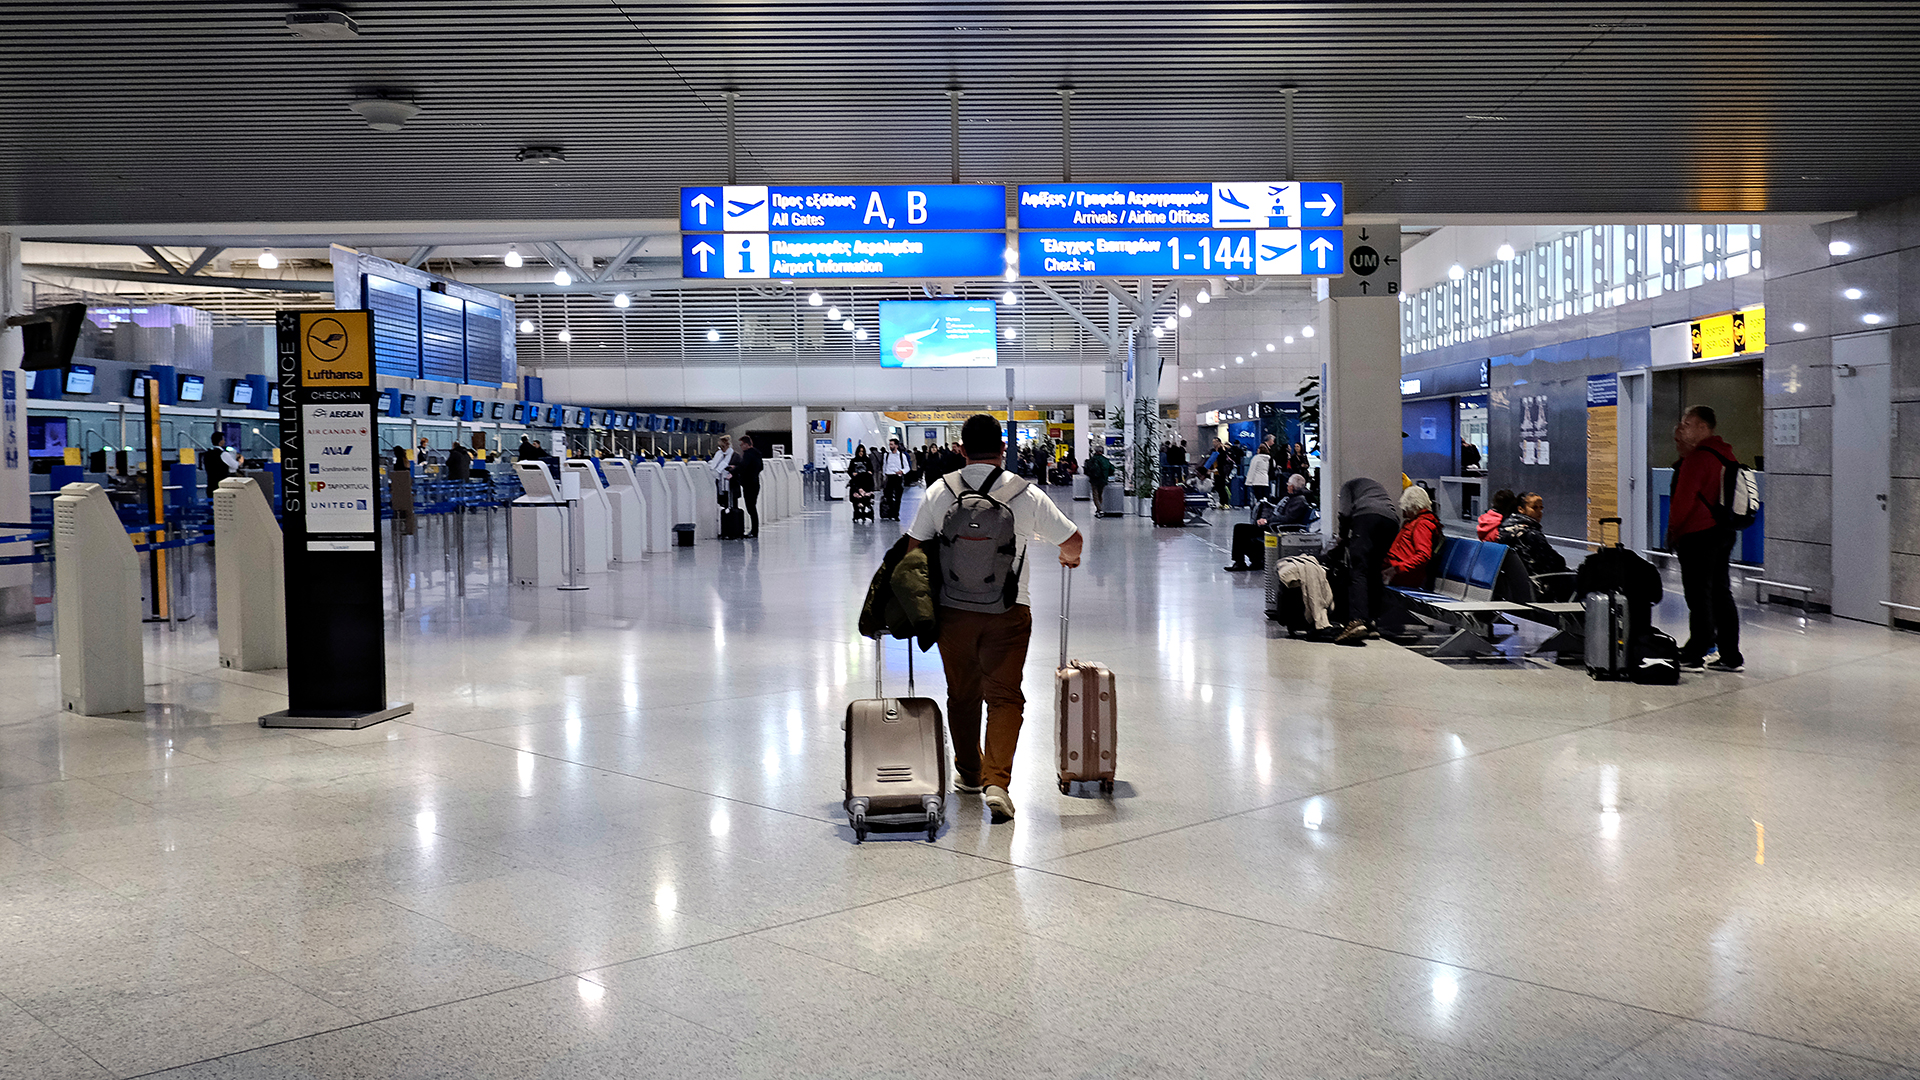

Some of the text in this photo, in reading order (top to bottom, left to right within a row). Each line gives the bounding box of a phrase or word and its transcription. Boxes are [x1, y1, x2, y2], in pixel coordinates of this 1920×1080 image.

[772, 193, 803, 210] Προς
[907, 190, 928, 224] B
[772, 212, 825, 226] All Gates
[1073, 210, 1118, 224] Arrivals
[1127, 209, 1166, 224] Airline
[1168, 209, 1210, 224] Offices
[1167, 236, 1253, 270] 1-144
[773, 258, 884, 276] Airport Information
[1043, 257, 1096, 272] Check-in
[1353, 254, 1377, 267] UM
[1387, 281, 1398, 294] B
[307, 369, 364, 380] Lufthansa
[311, 391, 361, 400] CHECK-IN
[329, 410, 364, 418] AEGEAN
[907, 412, 932, 420] Caring
[280, 341, 300, 511] STAR ALLIANCE
[321, 446, 344, 455] ANA
[311, 501, 354, 509] UNITED
